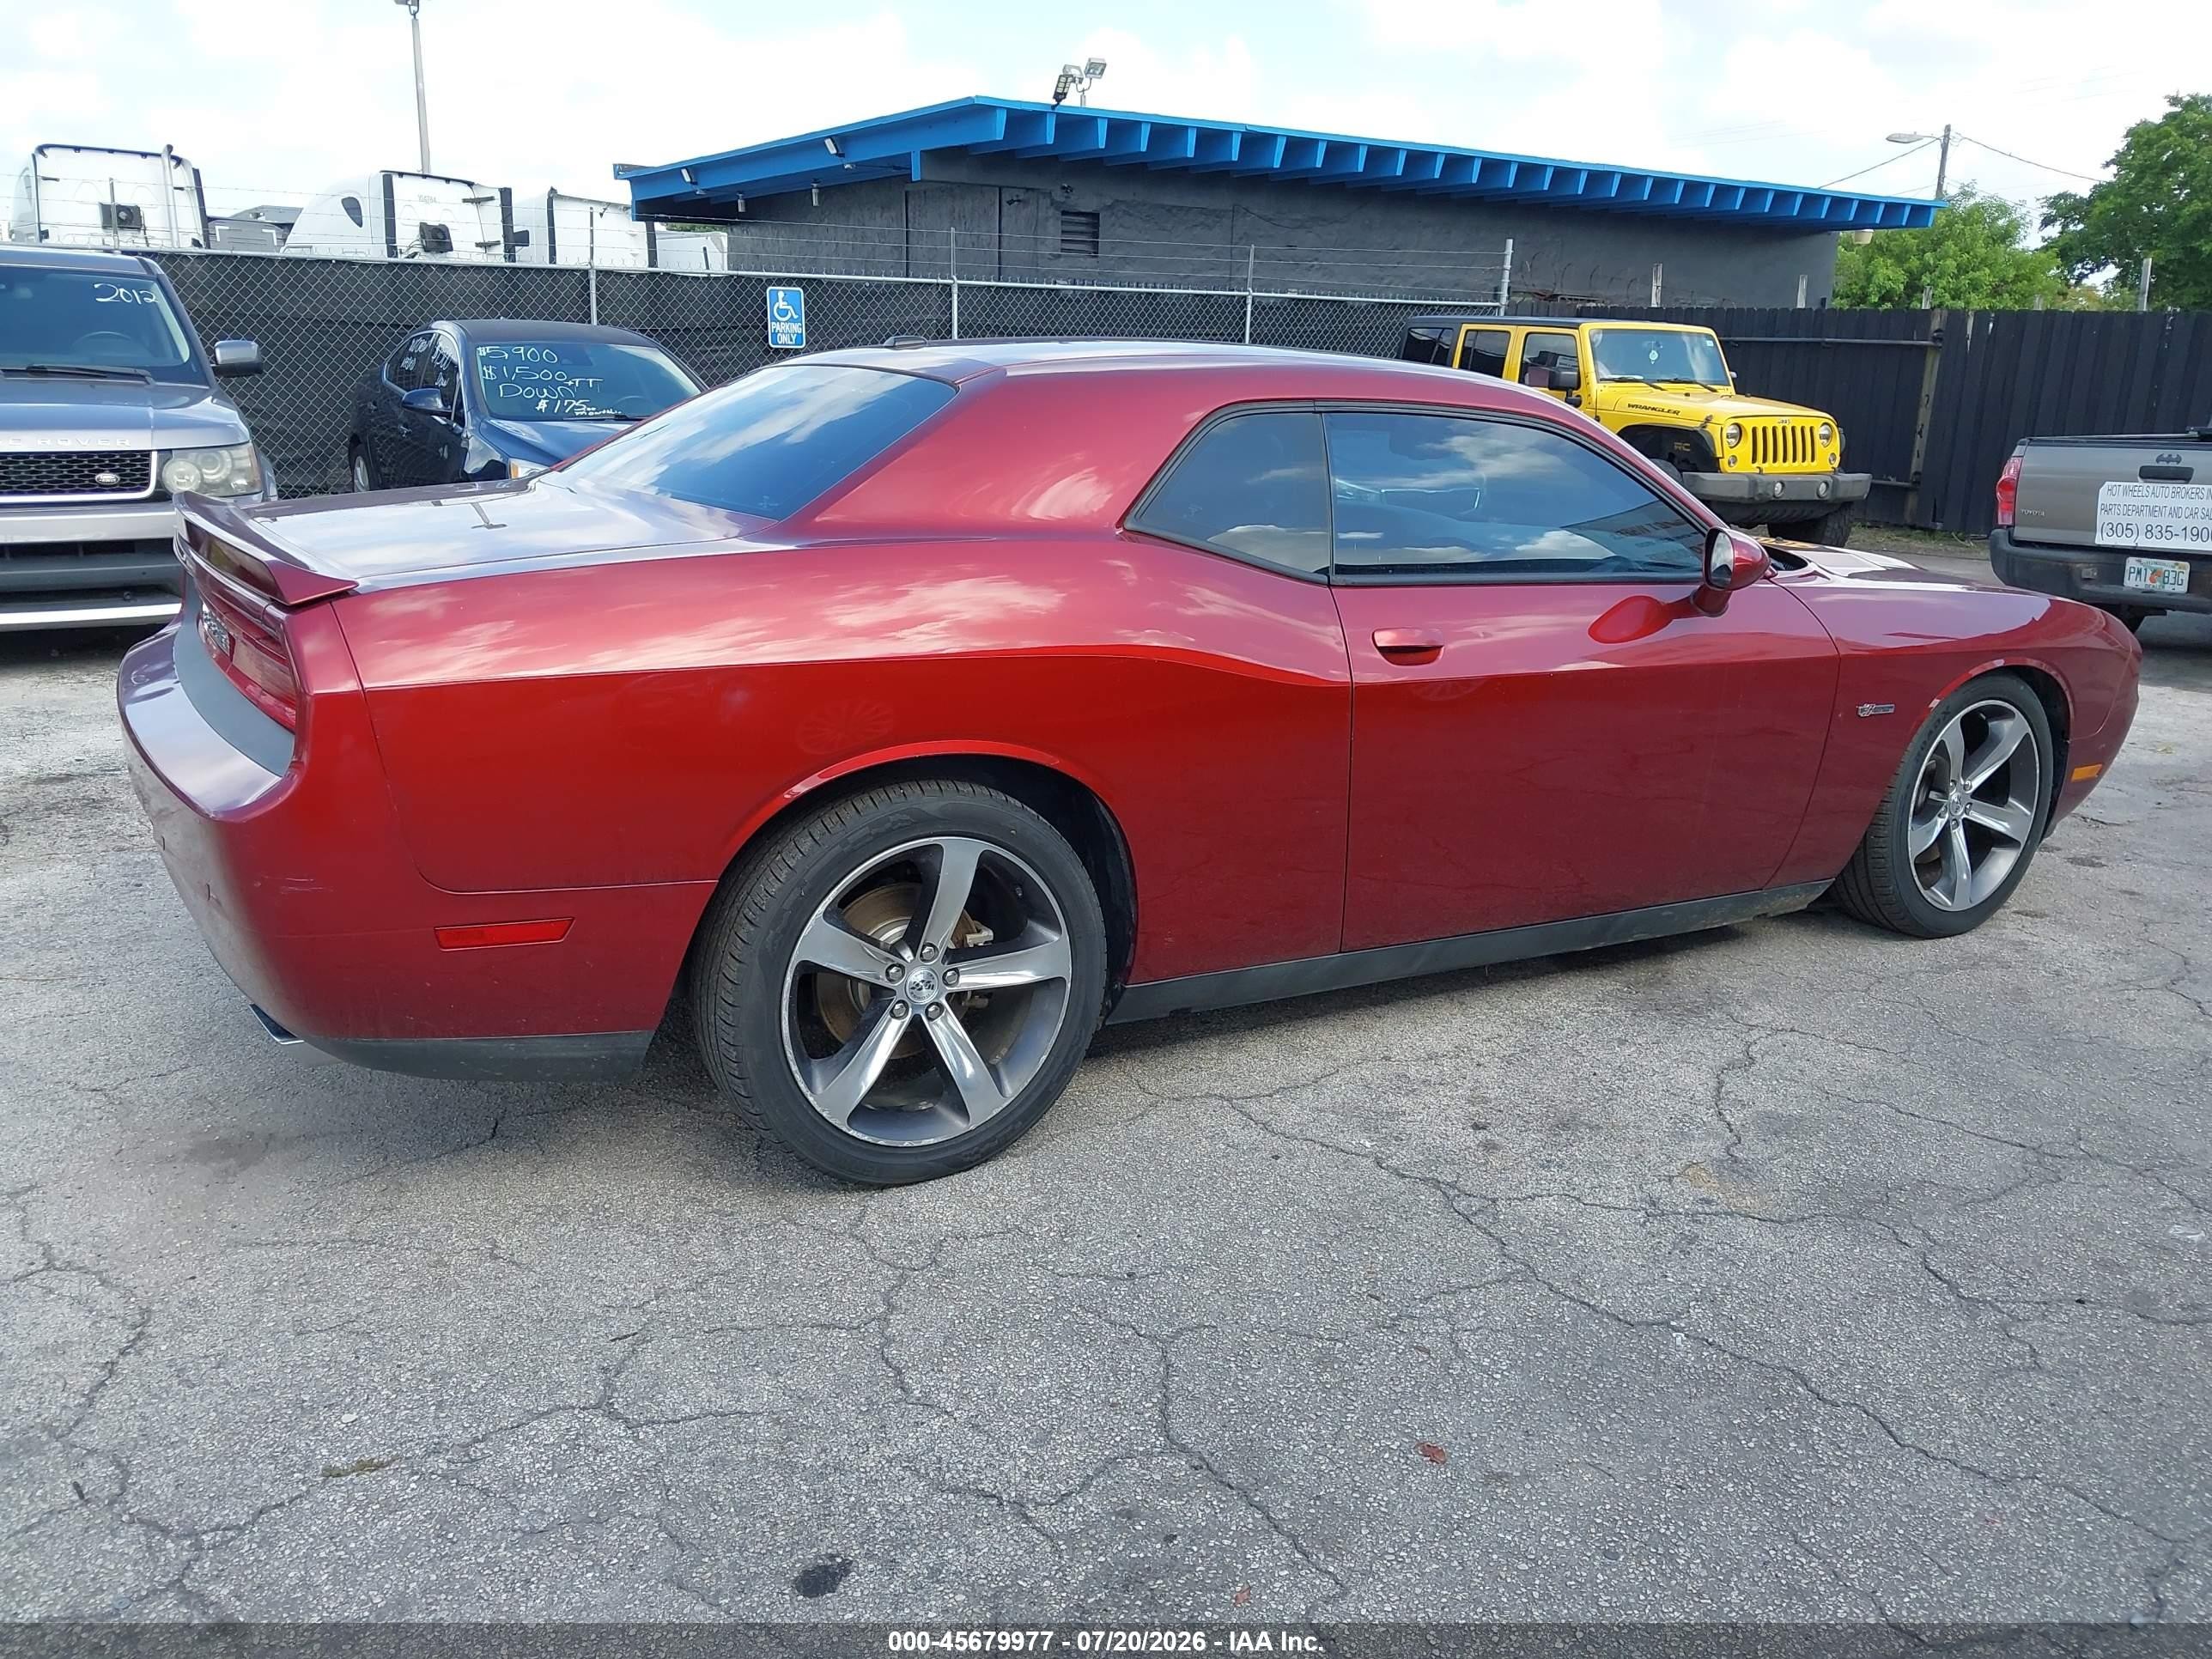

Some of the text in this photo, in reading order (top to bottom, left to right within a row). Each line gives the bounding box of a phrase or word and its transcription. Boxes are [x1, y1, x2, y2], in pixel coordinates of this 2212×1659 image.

[94, 283, 157, 305] 2012
[771, 322, 802, 334] PARKING
[777, 333, 797, 344] ONLY
[1627, 403, 1680, 416] WRANGLER
[37, 439, 131, 447] ROVER
[2107, 484, 2122, 496] HOT
[2123, 484, 2152, 498] WHEELS
[2151, 486, 2170, 499] AUTO
[2171, 487, 2205, 501] BROKERS
[2100, 503, 2122, 516] PARTS
[2123, 504, 2168, 519] DEPARTMENT
[2168, 506, 2183, 519] AND
[2185, 507, 2198, 520] CAR
[2100, 522, 2212, 543] (305) 835-190
